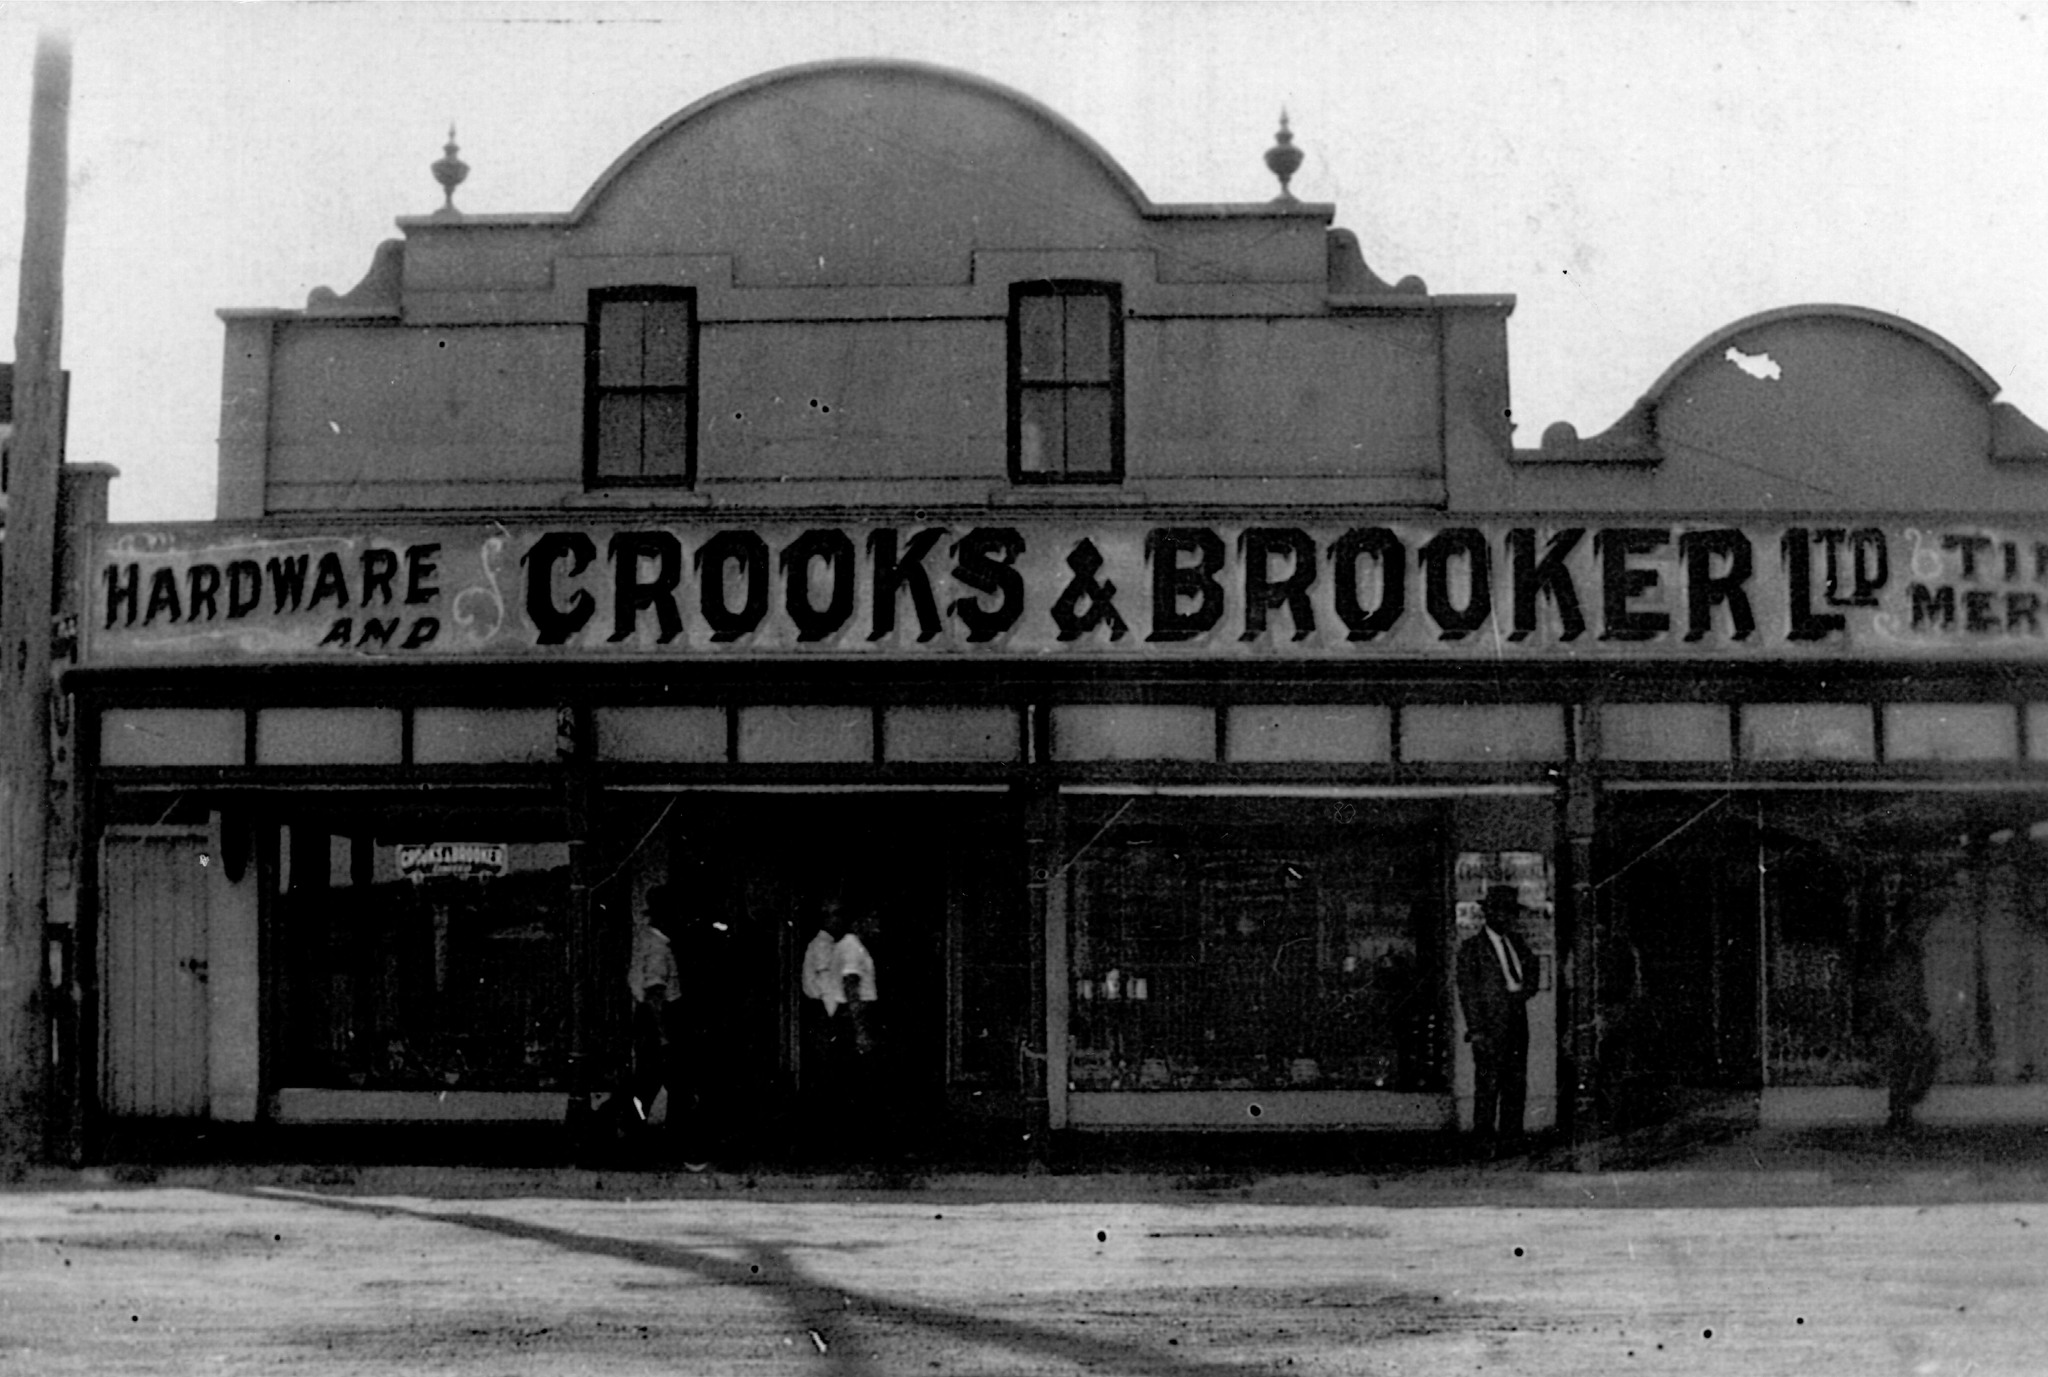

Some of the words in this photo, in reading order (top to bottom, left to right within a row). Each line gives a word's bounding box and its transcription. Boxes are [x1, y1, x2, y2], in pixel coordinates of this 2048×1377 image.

[104, 542, 442, 630] HARDWARE
[522, 529, 1024, 645] CROOKS
[1050, 537, 1129, 642] &
[1145, 526, 1756, 643] BROOKER
[321, 617, 440, 649] AND
